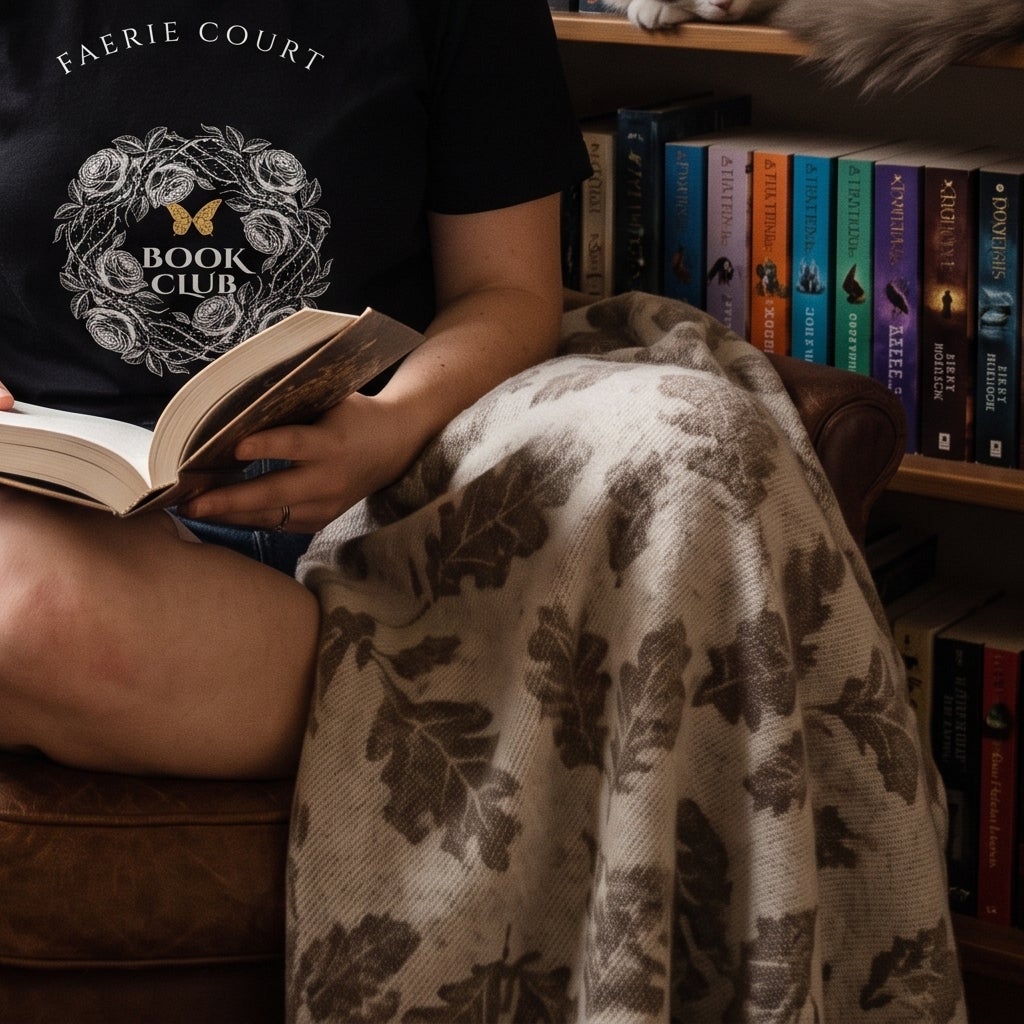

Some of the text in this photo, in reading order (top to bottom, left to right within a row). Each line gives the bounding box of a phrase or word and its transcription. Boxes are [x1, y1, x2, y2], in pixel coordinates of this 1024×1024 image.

[56, 21, 325, 75] FAERIE COURT
[142, 247, 256, 273] BOOK
[152, 273, 237, 298] CLUB
